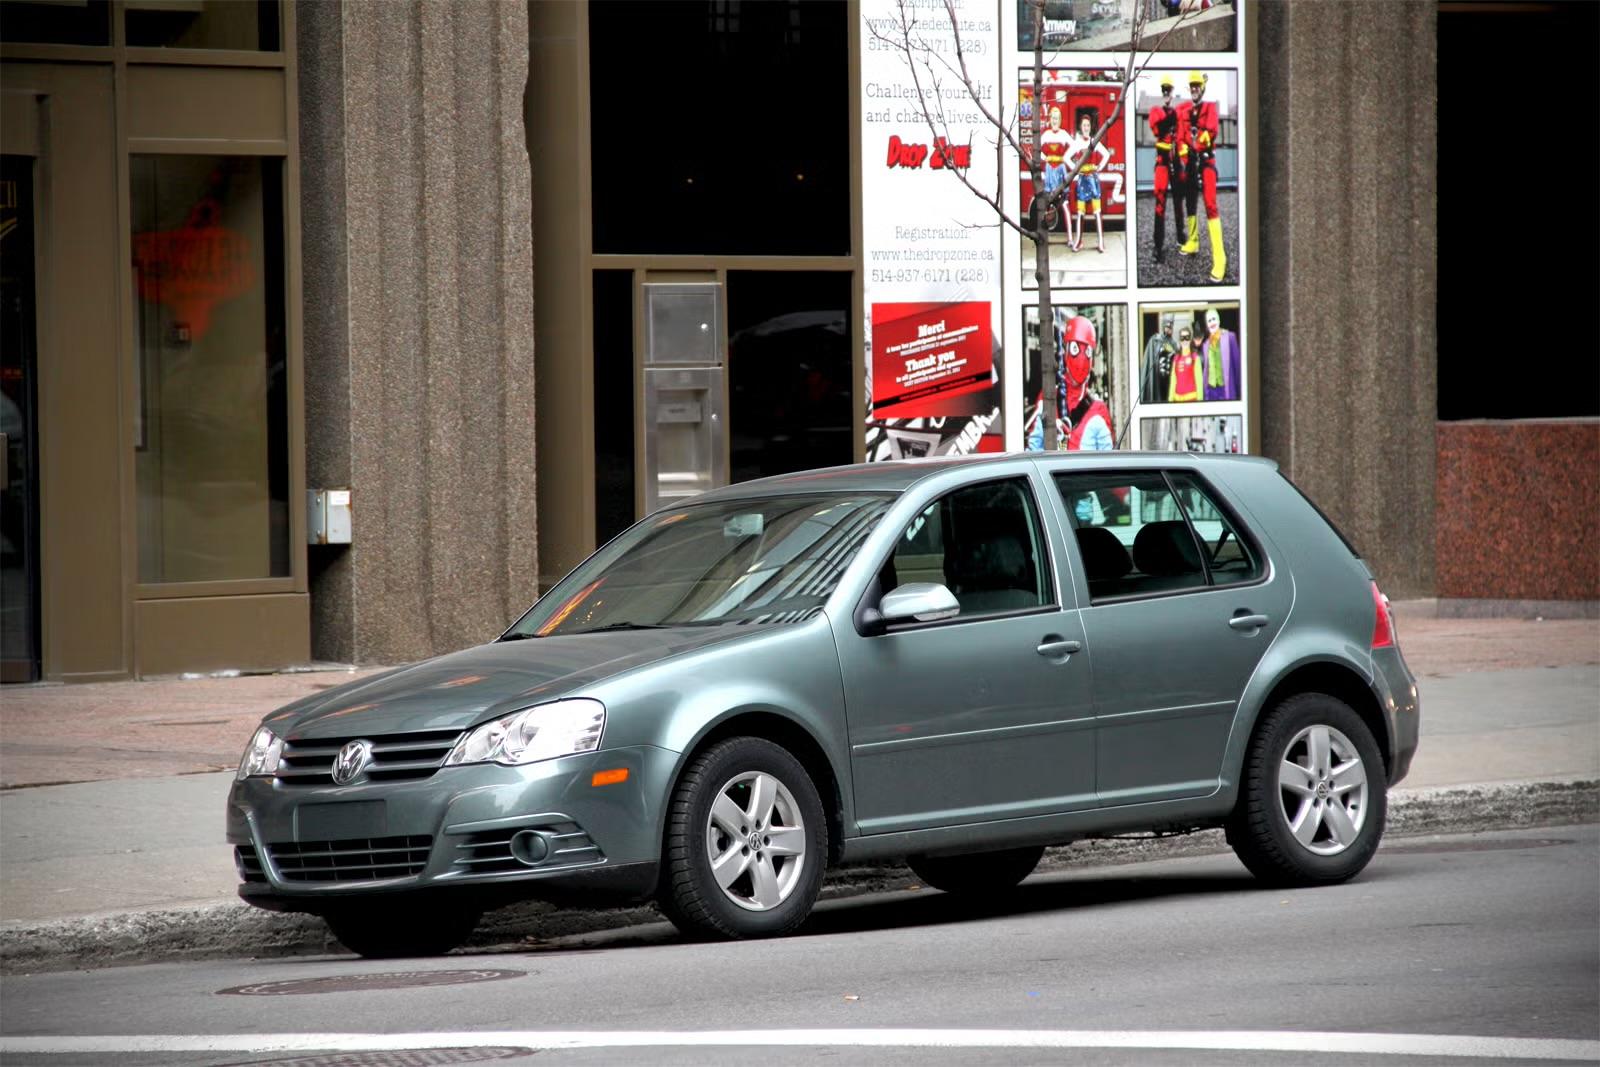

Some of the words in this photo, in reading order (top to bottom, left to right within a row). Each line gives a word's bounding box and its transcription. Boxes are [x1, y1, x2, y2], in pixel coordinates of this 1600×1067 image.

[866, 108, 891, 123] and
[896, 108, 941, 127] change
[872, 268, 950, 282] 514-937-6171
[955, 268, 989, 284] (228)
[918, 320, 945, 337] Merci
[905, 354, 937, 372] Thank
[937, 351, 955, 366] you
